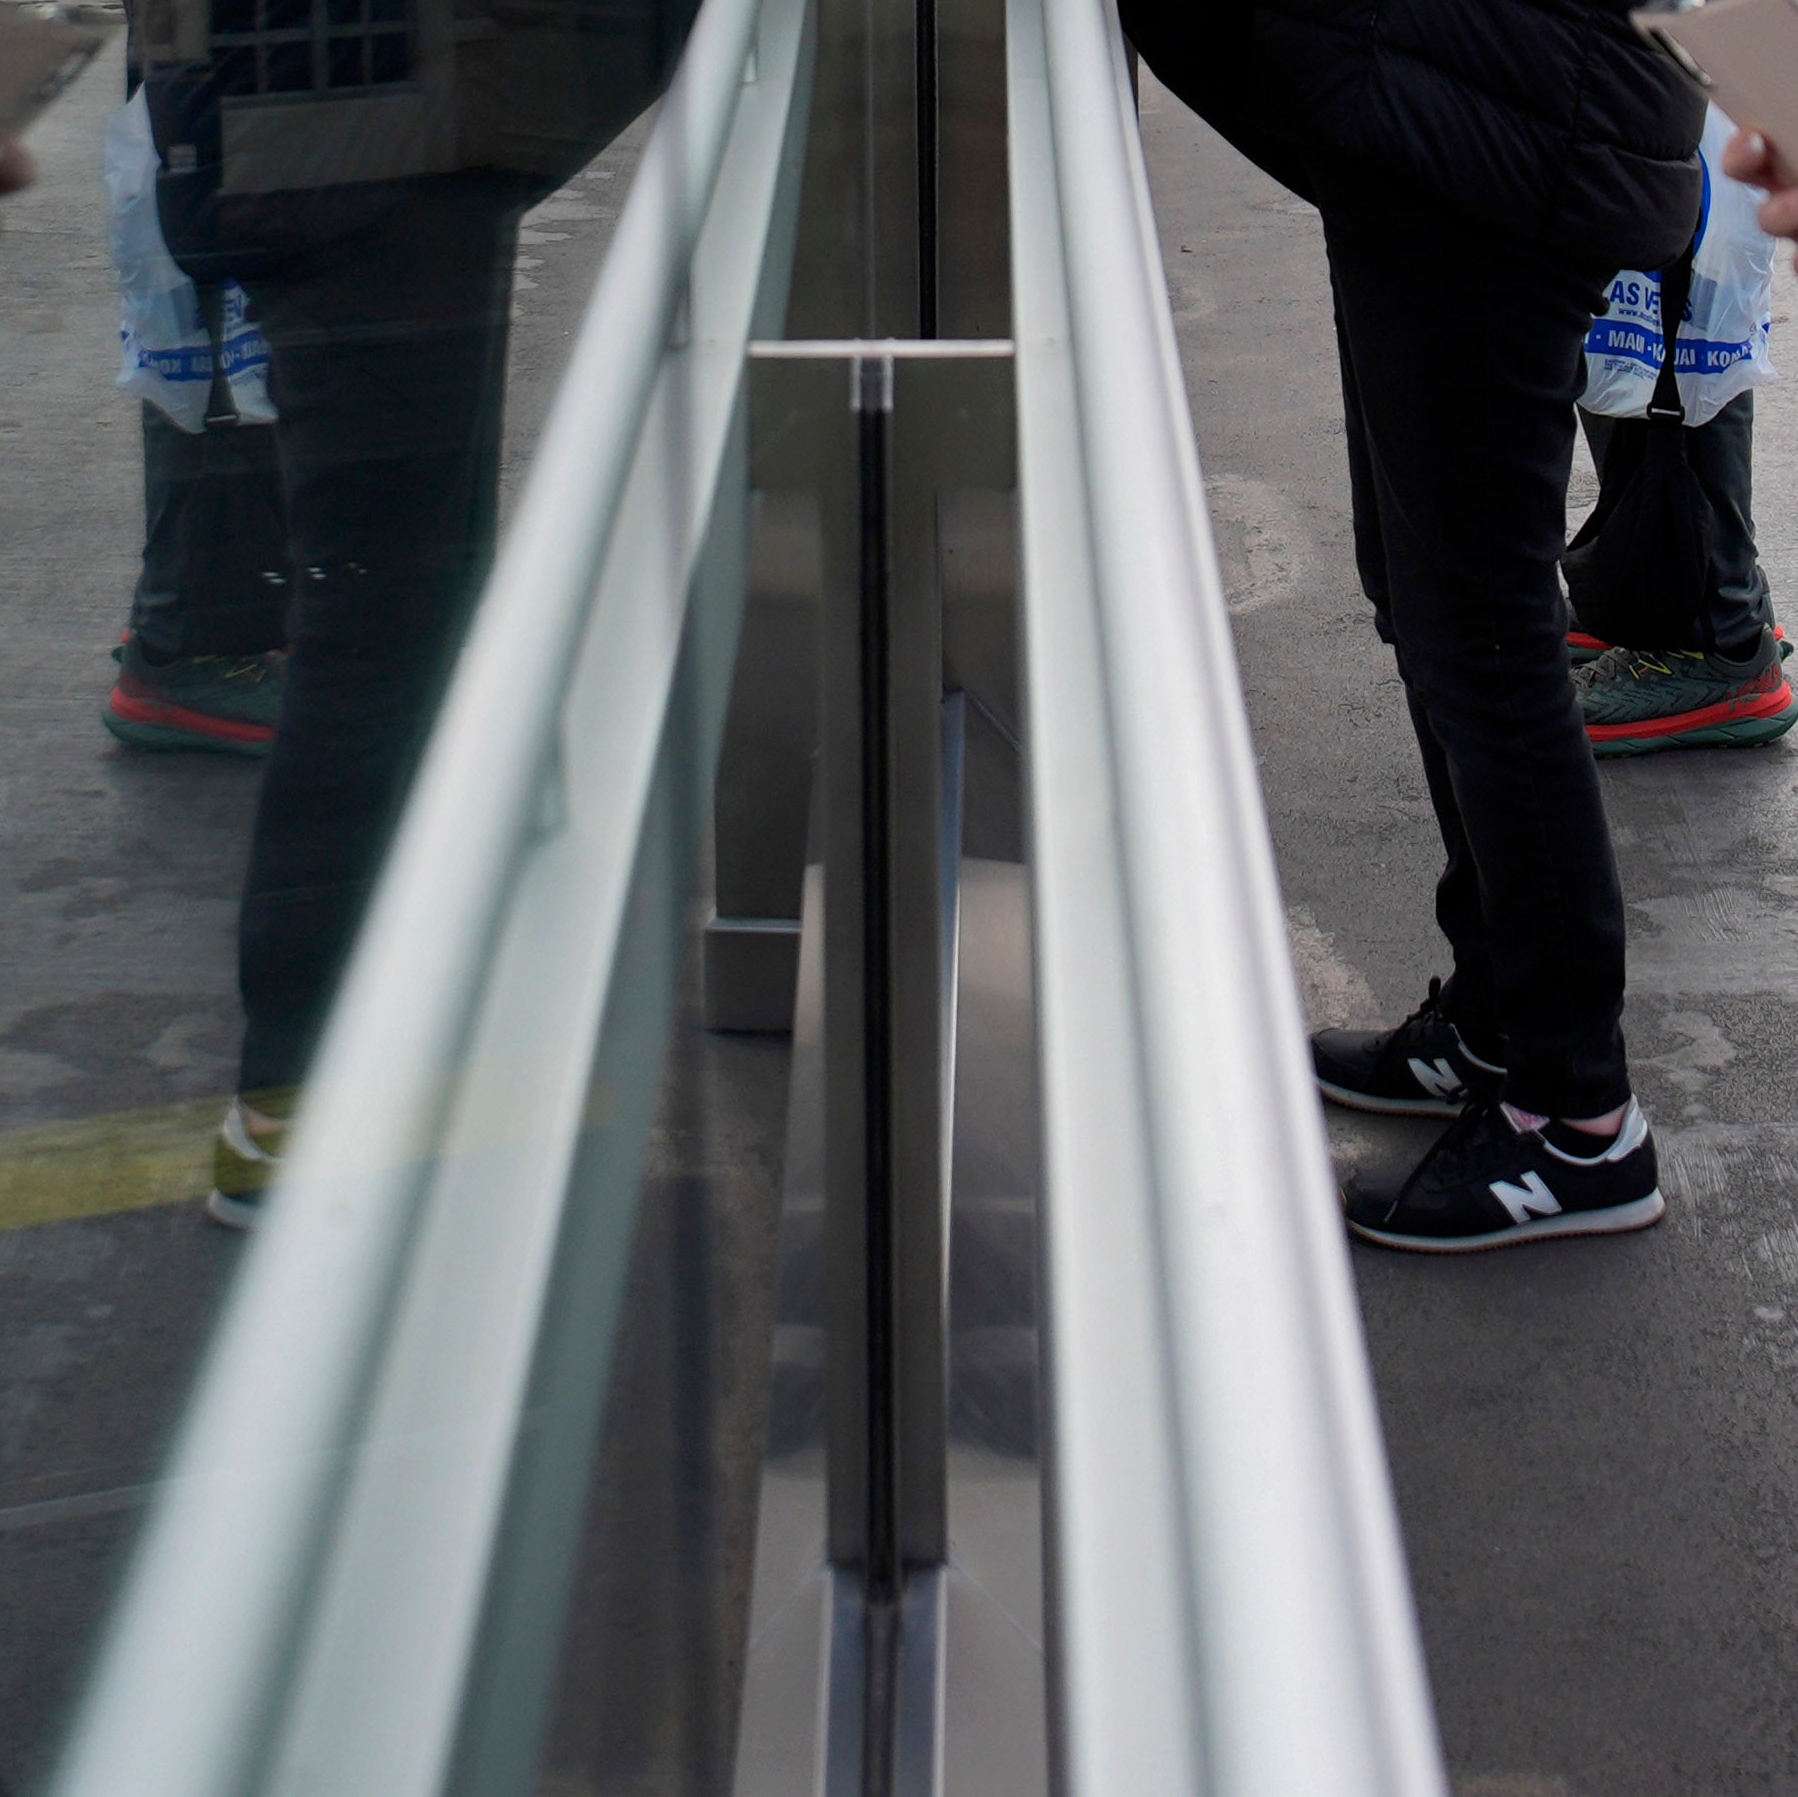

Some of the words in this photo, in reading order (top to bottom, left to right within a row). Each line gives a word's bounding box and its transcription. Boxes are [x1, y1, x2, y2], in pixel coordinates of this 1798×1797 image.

[1609, 280, 1641, 306] AS
[1408, 1057, 1469, 1099] N
[1489, 1169, 1563, 1224] N
